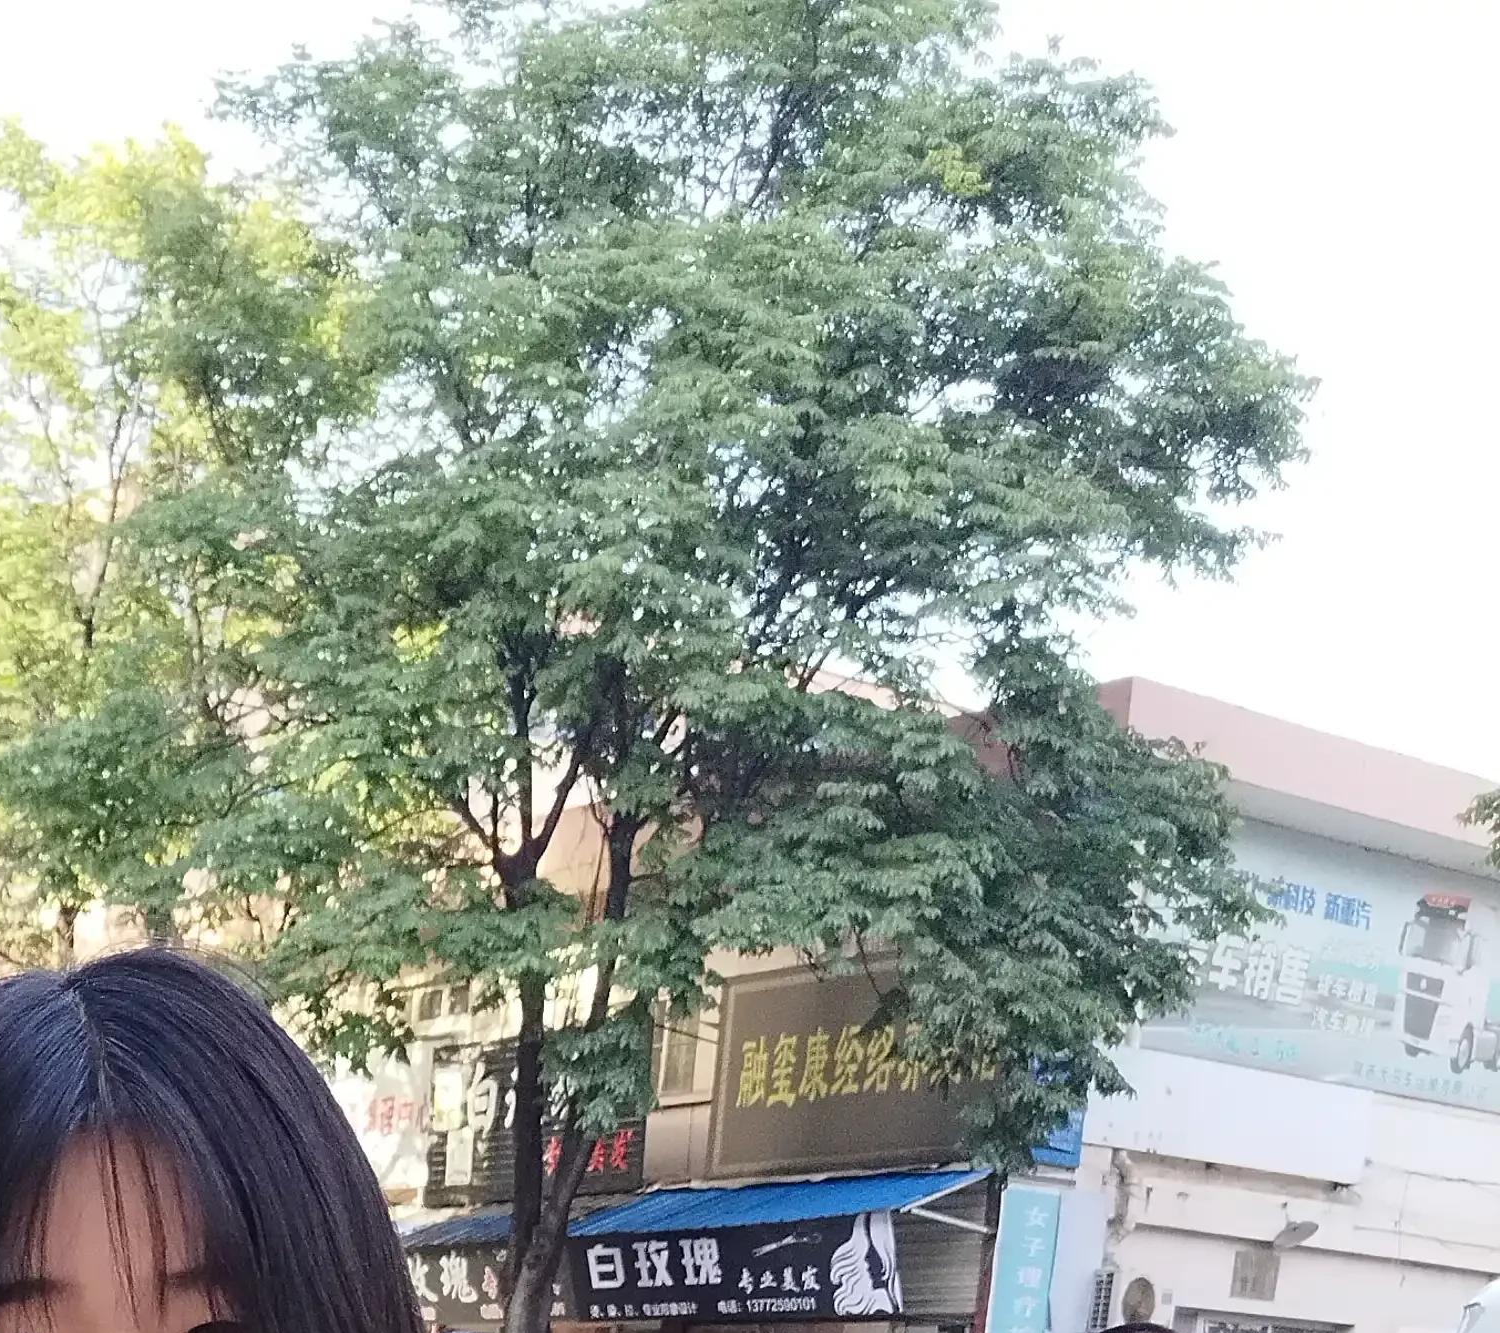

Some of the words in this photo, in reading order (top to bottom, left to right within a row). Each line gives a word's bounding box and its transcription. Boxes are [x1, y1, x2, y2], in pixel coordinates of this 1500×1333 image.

[586, 1236, 722, 1290] 白玫瑰
[737, 1264, 821, 1295] 专业美发
